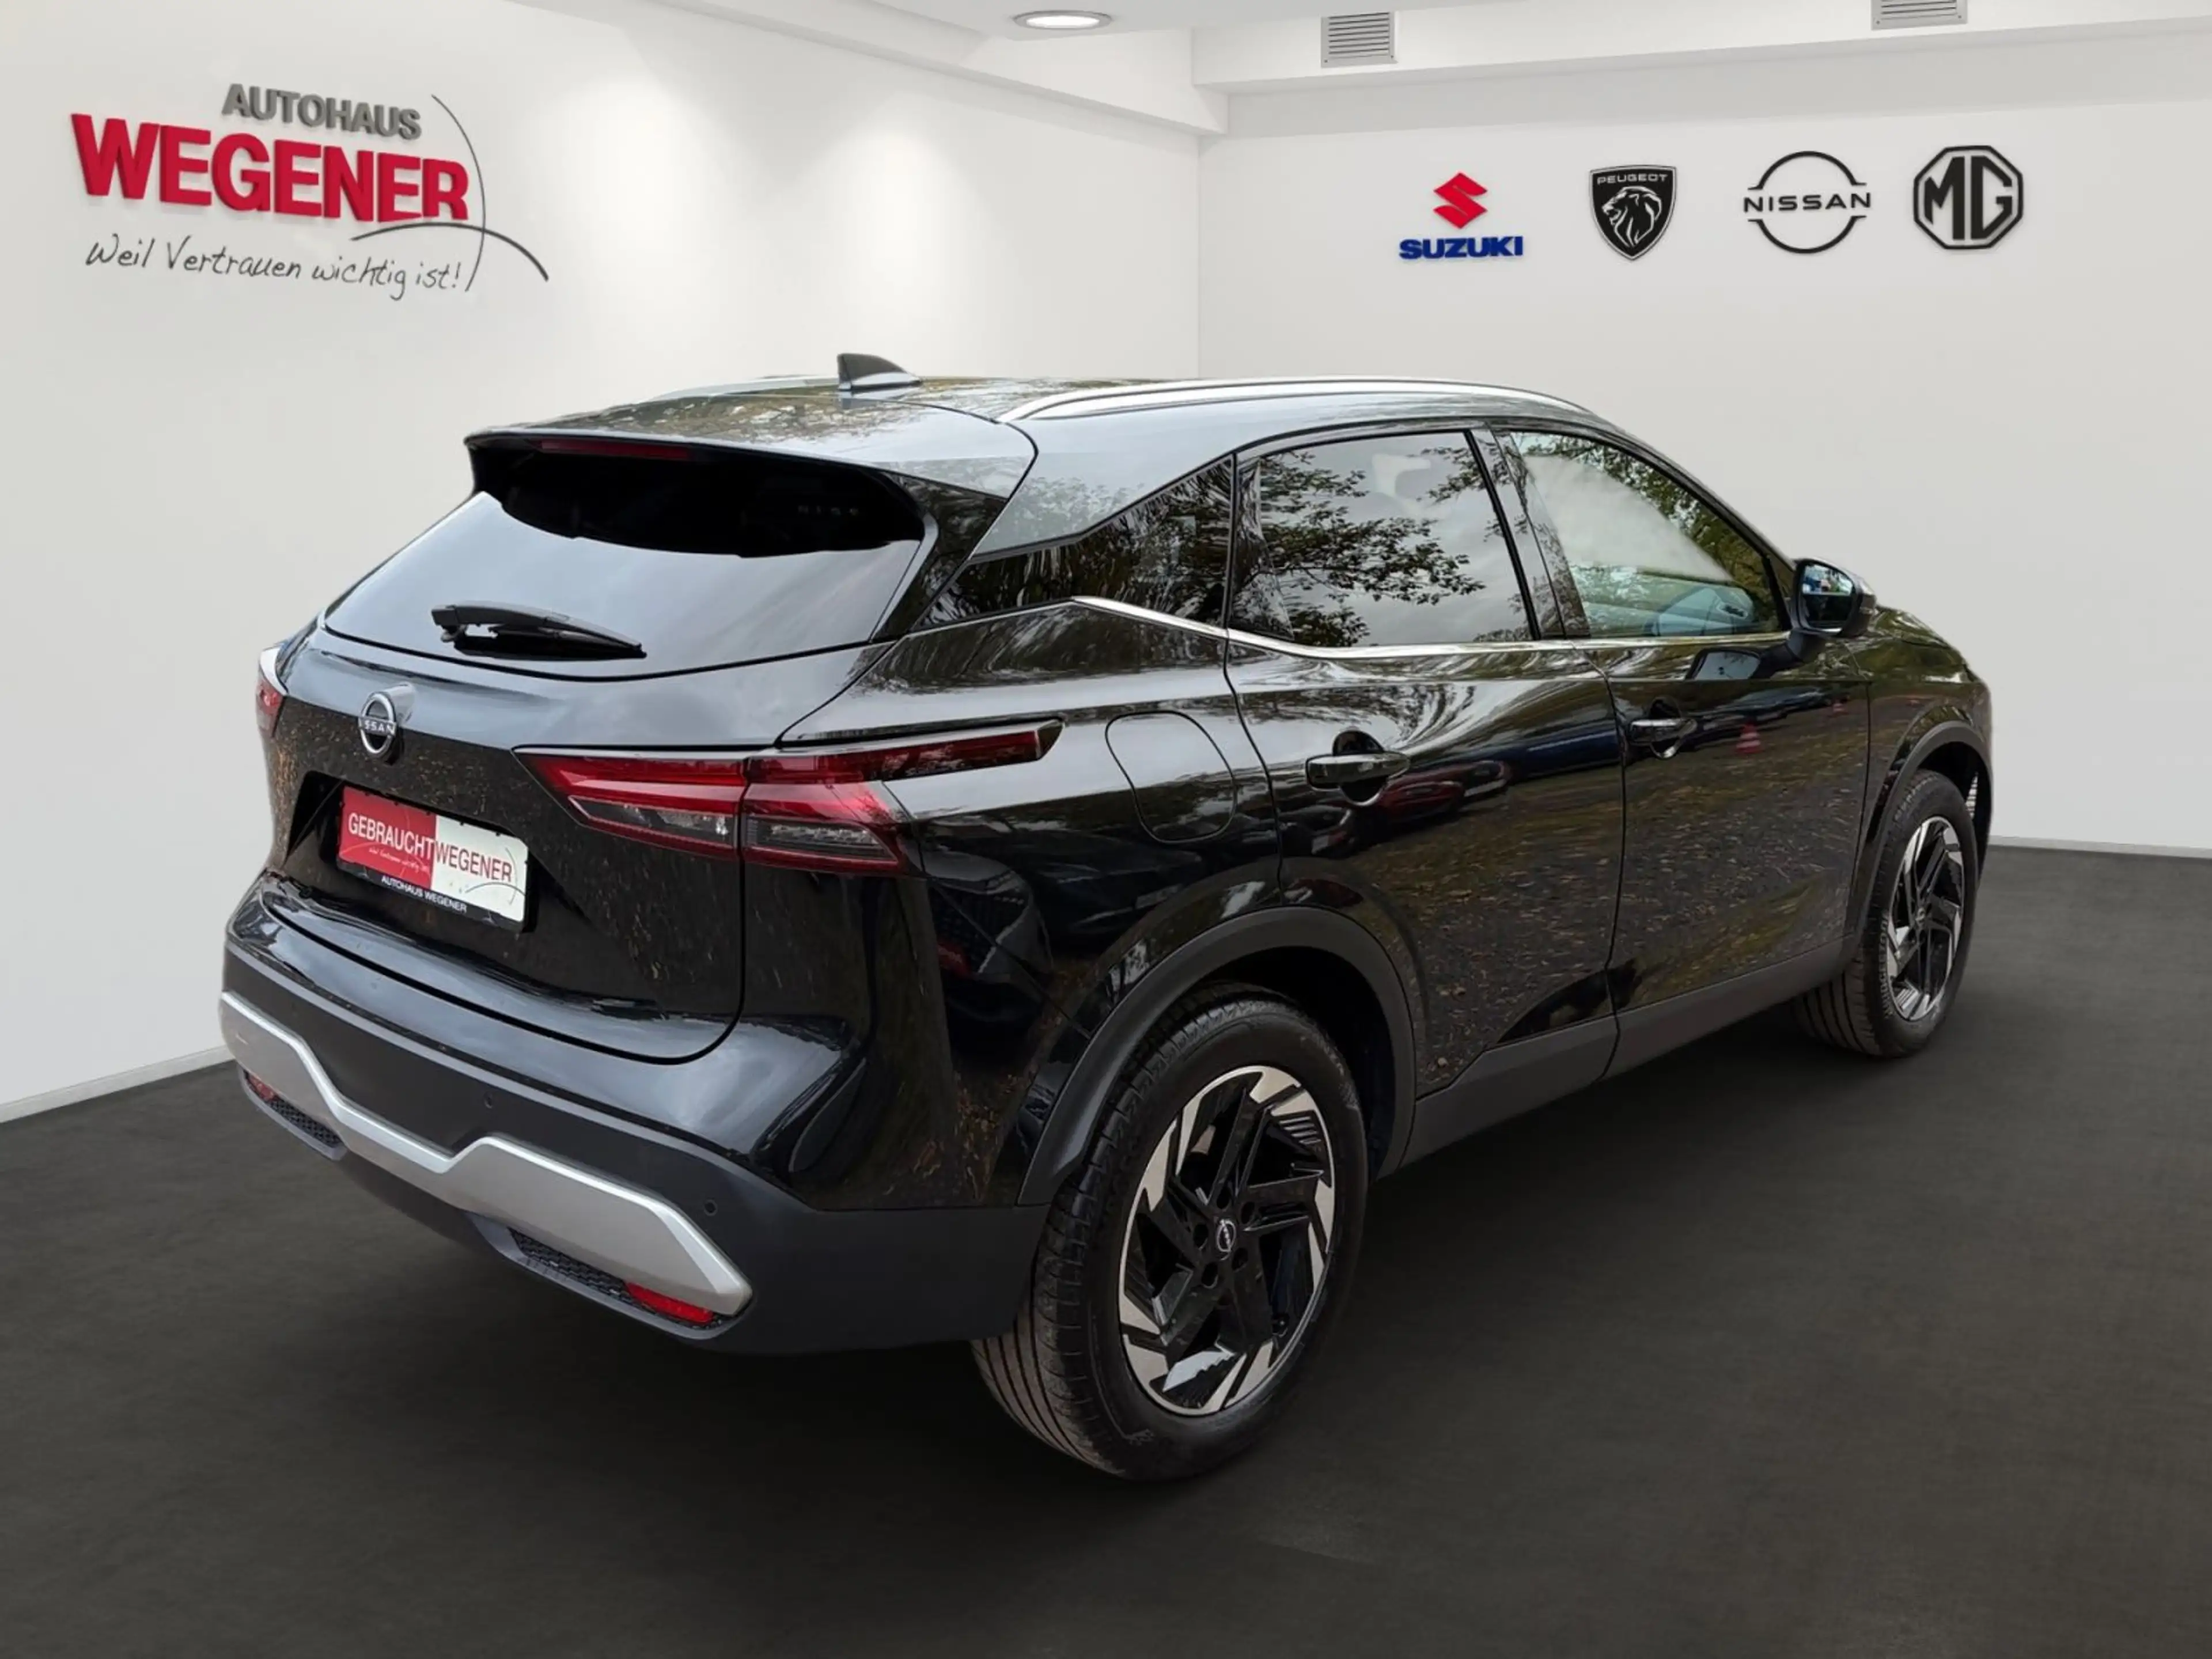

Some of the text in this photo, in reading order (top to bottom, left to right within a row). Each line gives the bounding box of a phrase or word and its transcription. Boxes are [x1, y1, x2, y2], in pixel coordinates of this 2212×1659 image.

[221, 82, 421, 141] AUTOHAUS
[70, 113, 469, 223] WEGENER
[1596, 173, 1668, 185] PEUGEOT
[1743, 191, 1872, 213] NISSAN
[1924, 155, 2013, 240] MG
[85, 233, 461, 301] Weil Vertrauen wichtig ist!
[1398, 236, 1524, 260] SUZUKI
[381, 874, 468, 914] AUTOHAUS WEGENER
